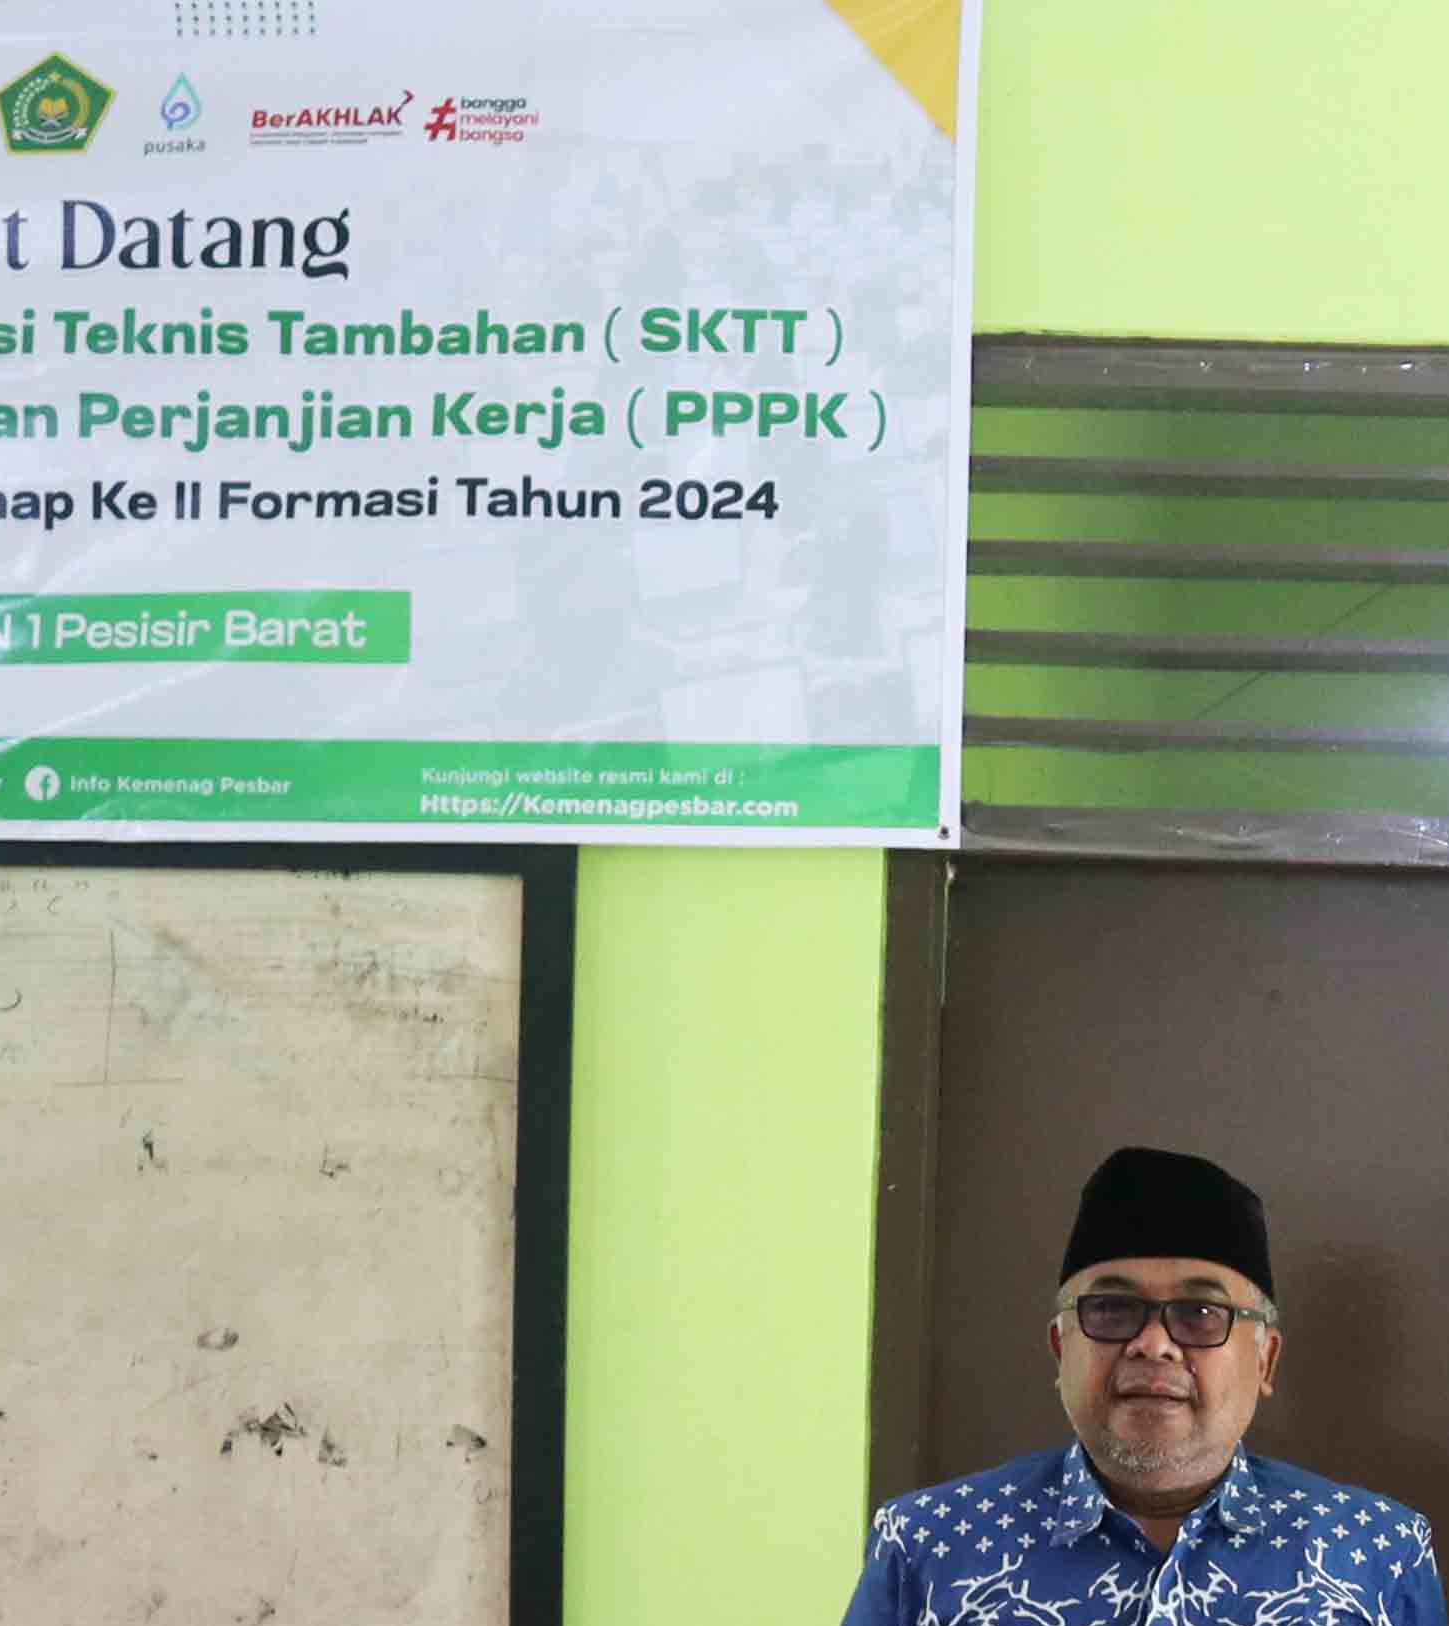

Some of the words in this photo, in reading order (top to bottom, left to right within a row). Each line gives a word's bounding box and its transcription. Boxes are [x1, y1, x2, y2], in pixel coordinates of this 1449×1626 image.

[460, 96, 527, 111] bangga
[251, 106, 403, 129] BerAKHLAK
[460, 111, 539, 128] melayani
[144, 138, 206, 156] pusaka
[459, 128, 524, 144] bangsa
[60, 200, 351, 280] Datang
[54, 308, 249, 355] Teknis
[268, 309, 585, 356] Tambahan
[640, 307, 808, 354] SKTT
[79, 387, 412, 453] Perjanjian
[431, 387, 605, 450] Kerja
[666, 390, 849, 438] PPPK
[91, 480, 158, 521] Ke
[219, 476, 438, 520] Formasi
[457, 477, 622, 520] Tahun
[638, 479, 780, 520] 2024
[27, 612, 42, 647] 1
[56, 611, 211, 649] Pesisir
[224, 610, 367, 649] Barat
[70, 776, 111, 793] Info
[116, 776, 214, 796] Kemenag
[220, 776, 292, 794] Pesbar
[421, 767, 509, 788] Kunjungi
[516, 768, 592, 785] website
[598, 768, 652, 785] resmi
[659, 768, 707, 785] kami
[714, 768, 735, 786] di
[420, 793, 799, 821] Https://Kemenagpesbar.com
